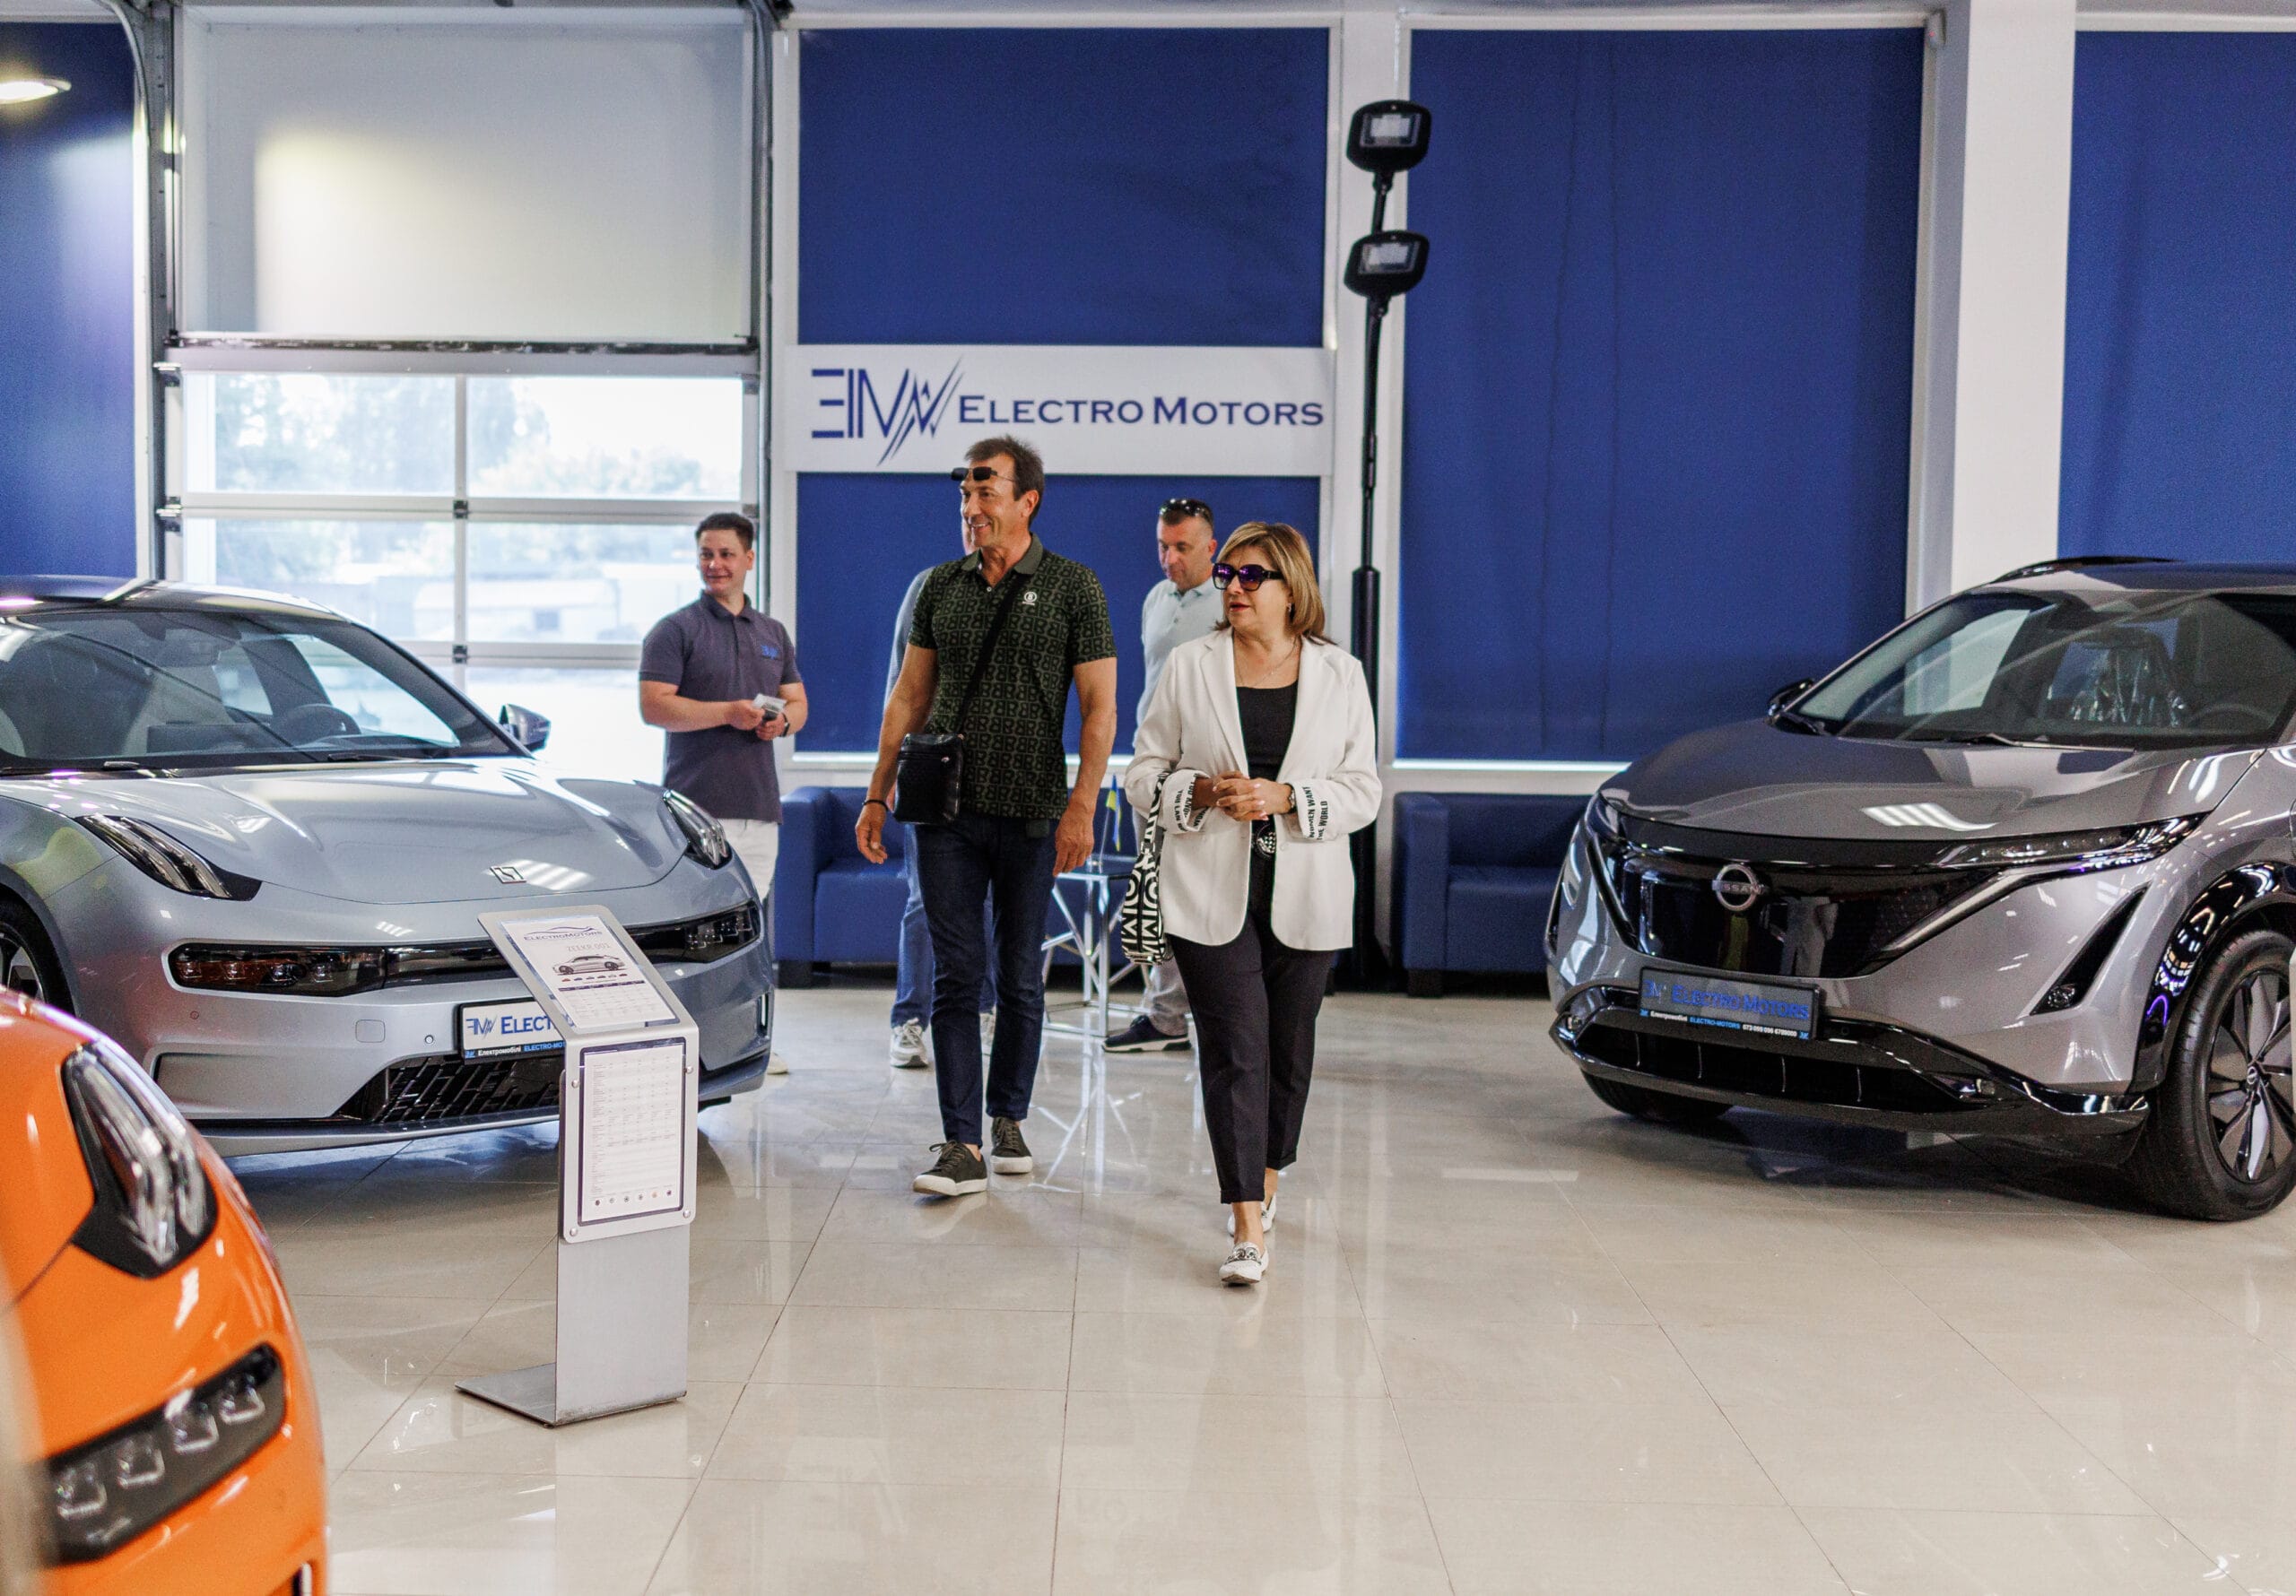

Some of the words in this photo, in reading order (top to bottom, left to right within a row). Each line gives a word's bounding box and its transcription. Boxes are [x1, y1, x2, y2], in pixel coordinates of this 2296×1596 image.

[958, 395, 1144, 425] ELECTRO
[1152, 396, 1325, 427] MOTORS
[1302, 786, 1316, 807] WANT
[1318, 801, 1328, 827] WORLD
[523, 931, 603, 941] ELECTROMOTORS
[567, 943, 591, 952] ZEEKR
[1672, 984, 1741, 1011] ELECTRO
[1743, 994, 1809, 1020] MOTORS
[500, 1015, 552, 1036] ELECT
[477, 1046, 522, 1056] Електромобілі
